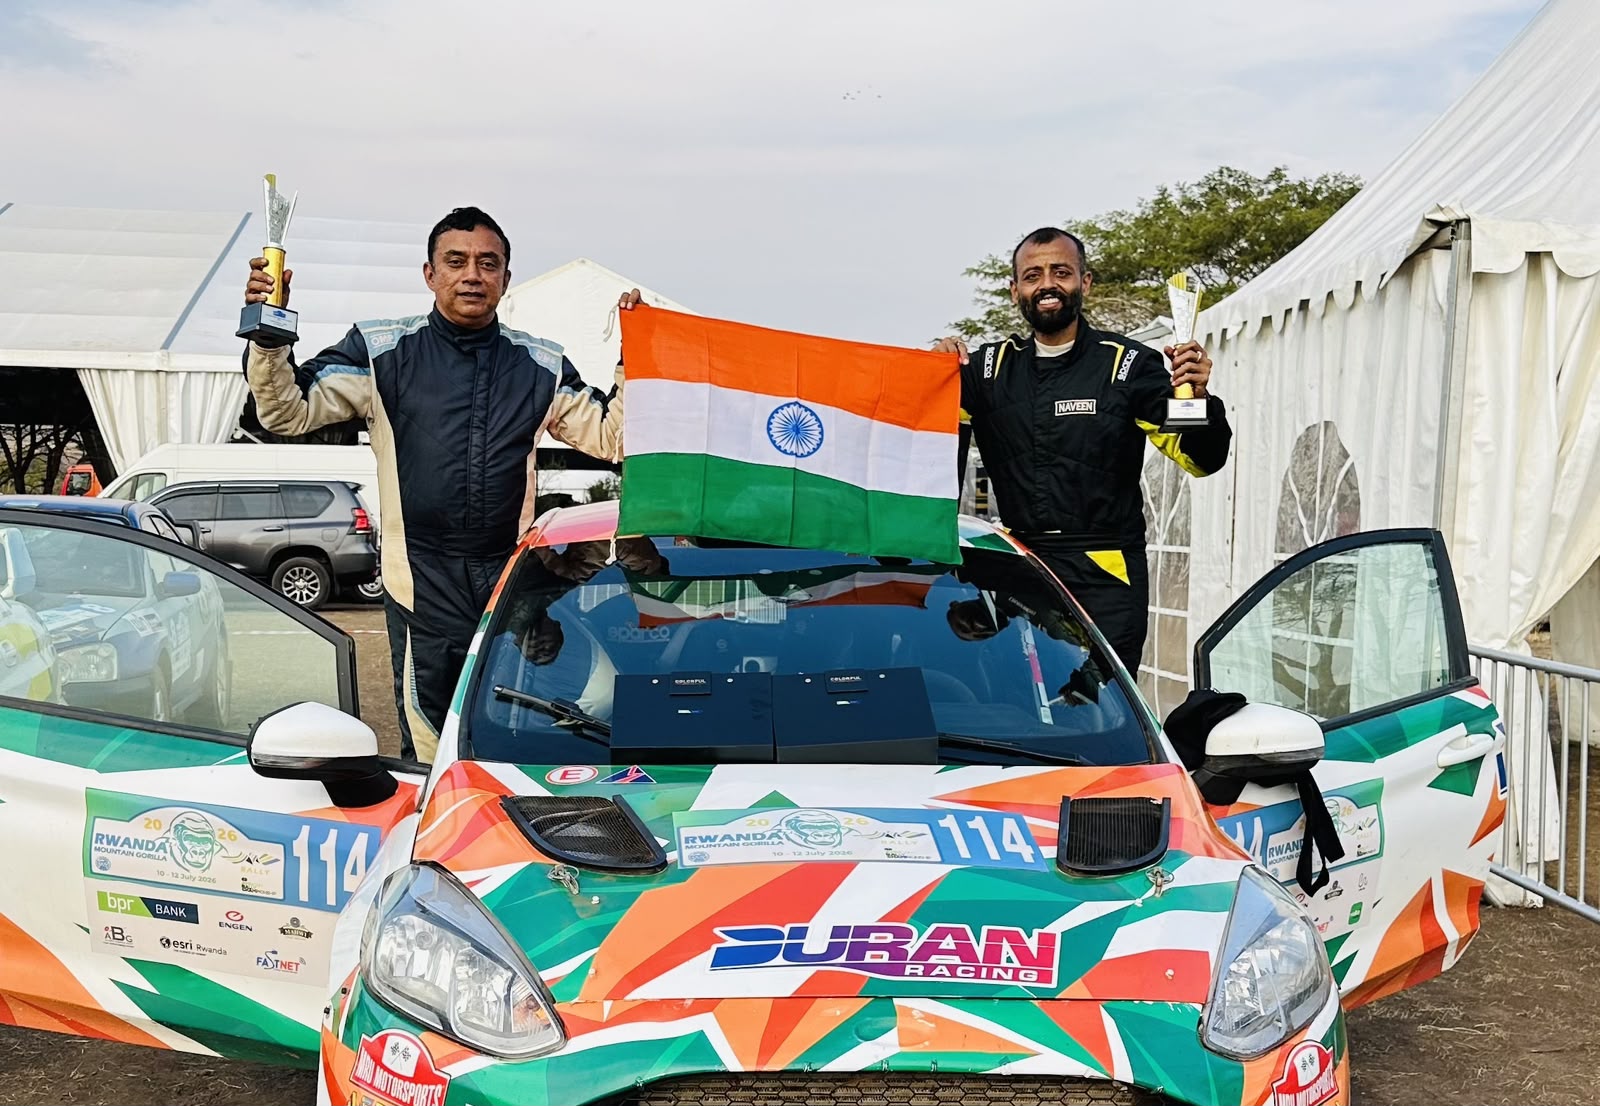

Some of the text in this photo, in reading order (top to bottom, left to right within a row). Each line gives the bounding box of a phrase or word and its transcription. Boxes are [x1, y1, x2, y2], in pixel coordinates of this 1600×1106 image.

[984, 346, 995, 379] sparco
[1117, 349, 1138, 381] sparco
[1058, 402, 1093, 413] NAVEEN
[607, 625, 670, 641] sparco
[144, 817, 162, 831] 20
[745, 819, 769, 827] 20
[843, 817, 869, 825] 26
[217, 828, 238, 841] 26
[684, 832, 783, 844] RWANDA
[938, 813, 1035, 863] 114
[94, 833, 168, 853] RWANDA
[685, 842, 740, 850] MOUNTAIN
[94, 846, 168, 862] MOUNTAIN GORILLA
[293, 825, 369, 906] 114
[156, 869, 165, 877] 10
[171, 871, 179, 879] 12
[180, 874, 197, 882] July
[198, 876, 217, 884] 2026
[106, 892, 187, 918] bpr BANK
[218, 921, 253, 932] ENGEN
[172, 939, 193, 950] esri
[196, 943, 228, 956] Rwanda
[710, 924, 1056, 971] DURAN
[256, 950, 300, 972] FASTNET
[905, 964, 1038, 982] RACING
[372, 1065, 444, 1106] MOTORSPORTS
